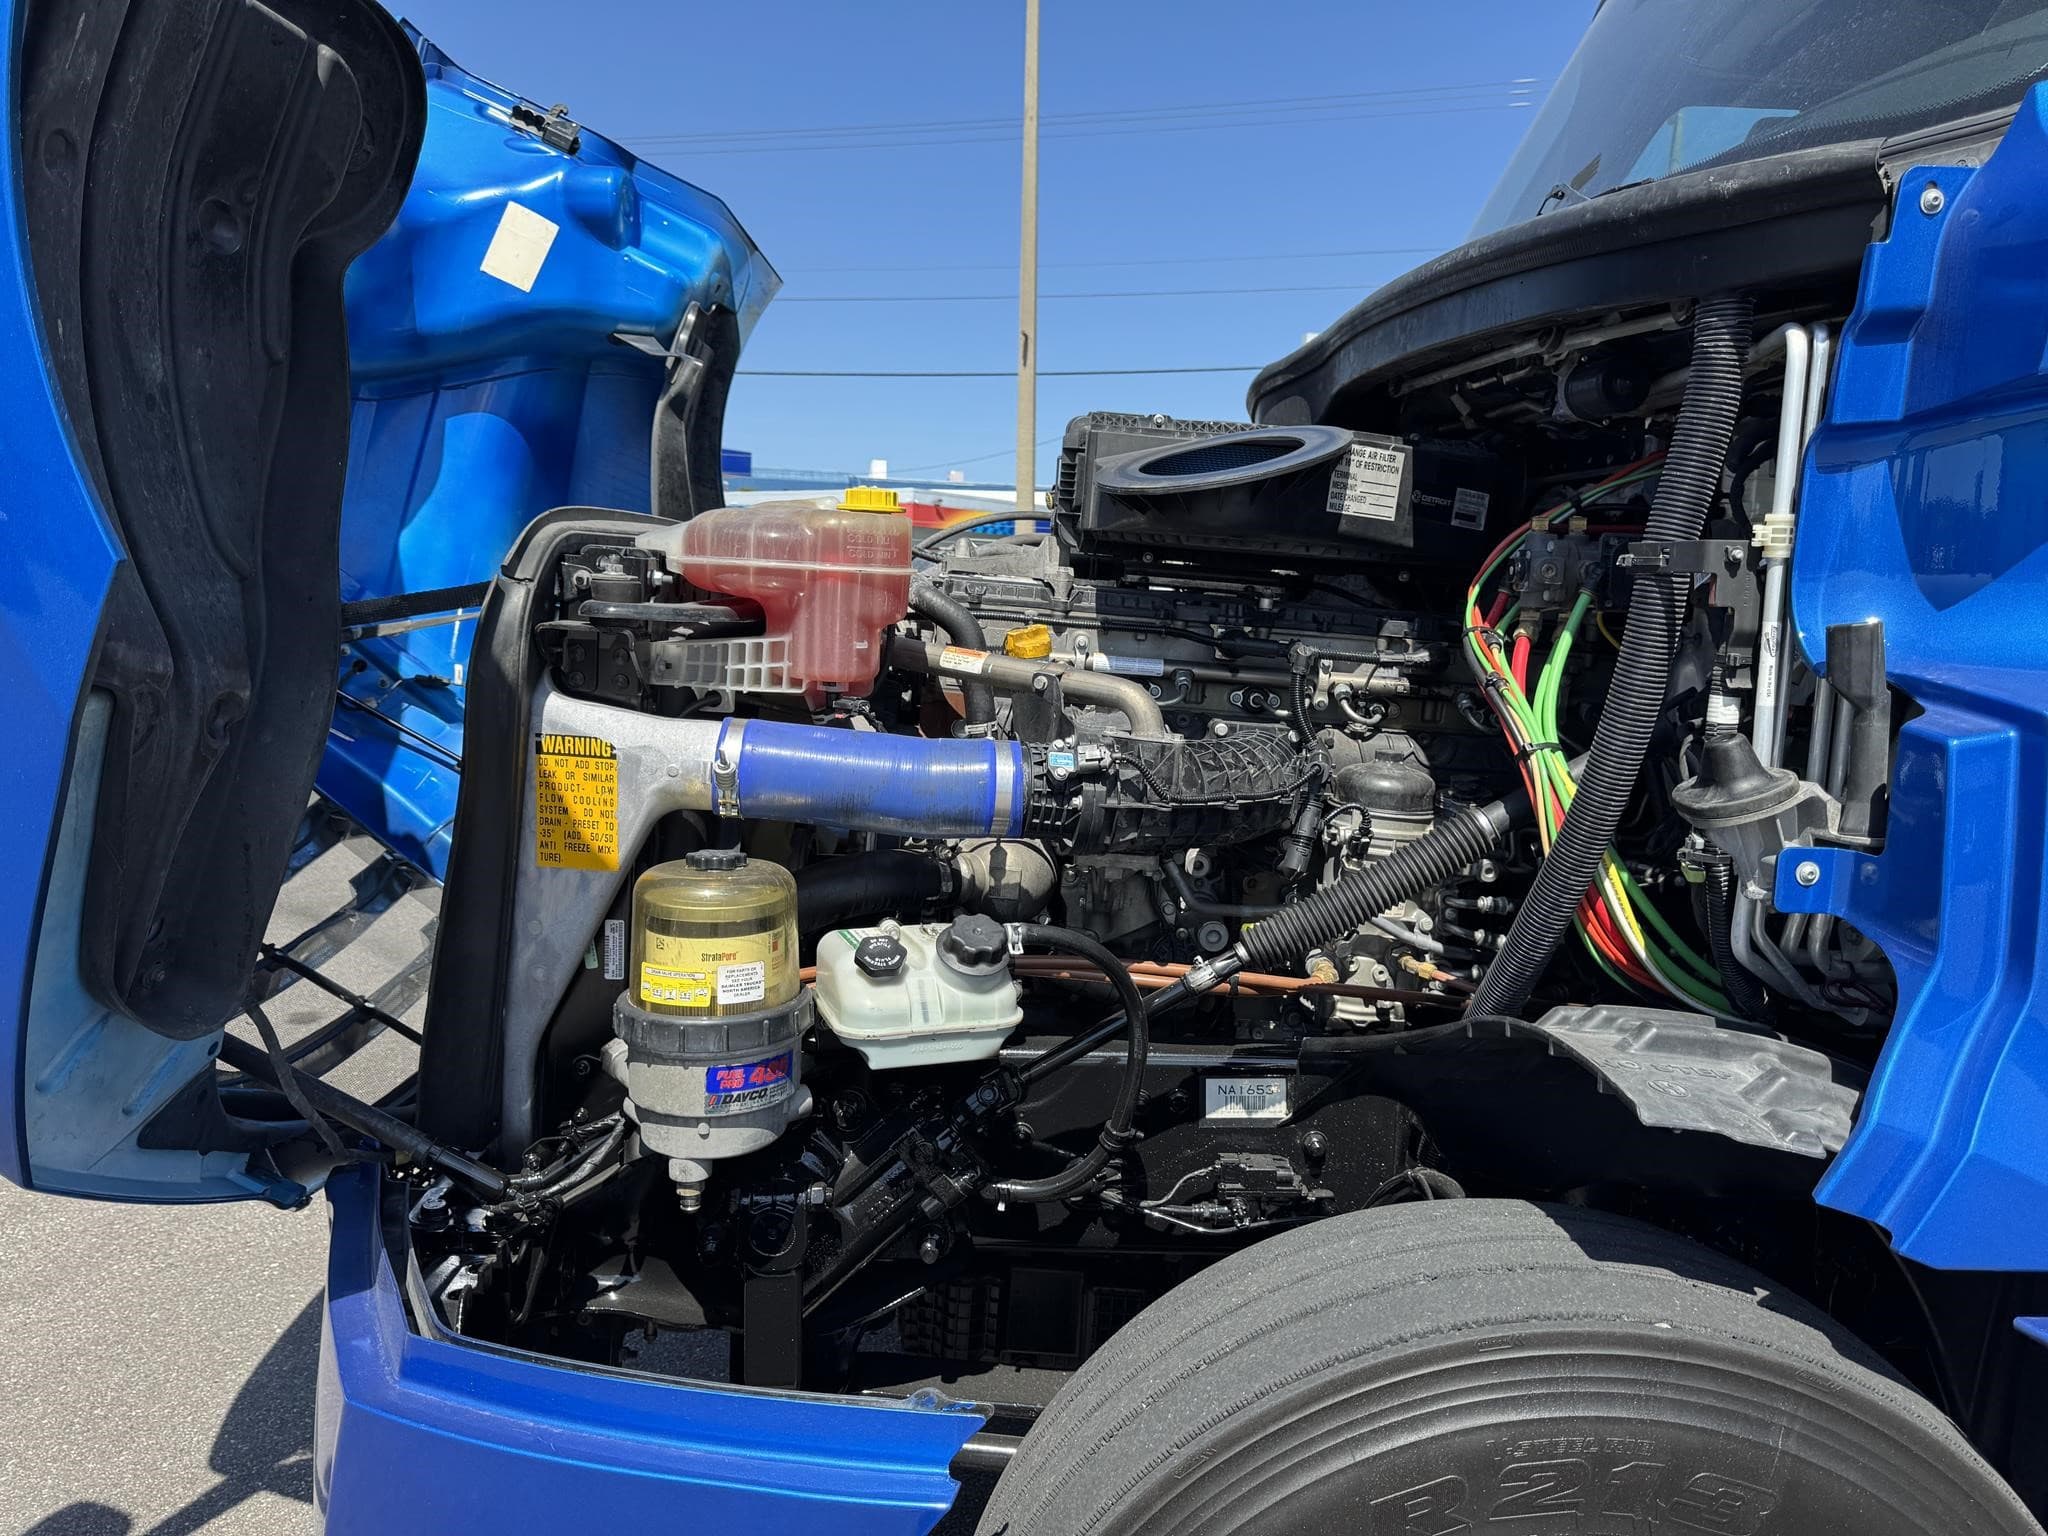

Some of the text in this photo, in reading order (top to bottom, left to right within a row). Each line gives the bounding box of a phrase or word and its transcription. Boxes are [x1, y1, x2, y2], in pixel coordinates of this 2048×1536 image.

[1368, 451, 1378, 461] AIR
[1380, 452, 1397, 464] FILTER
[1355, 459, 1363, 469] OF
[1364, 461, 1400, 475] RESTRICTION
[1334, 469, 1358, 481] TERMINAL
[1330, 491, 1344, 501] DATE
[541, 735, 612, 758] WARNING
[538, 757, 549, 767] DO
[554, 759, 569, 768] NOT
[574, 760, 590, 770] ADD
[538, 769, 615, 783] LEAK OR SIMILAR
[595, 784, 615, 795] LOW
[538, 792, 615, 808] FLOW COOLING
[538, 804, 569, 816] SYSTEM
[583, 807, 594, 818] DO
[599, 809, 614, 820] NOT
[539, 816, 562, 827] DRAIN
[572, 818, 600, 830] PRESET
[605, 821, 615, 831] TO
[590, 831, 614, 843] 50/50
[539, 839, 557, 850] ANTI
[564, 841, 591, 853] FREEZE
[701, 952, 737, 963] StrataPore
[721, 1087, 769, 1105] DAVCO
